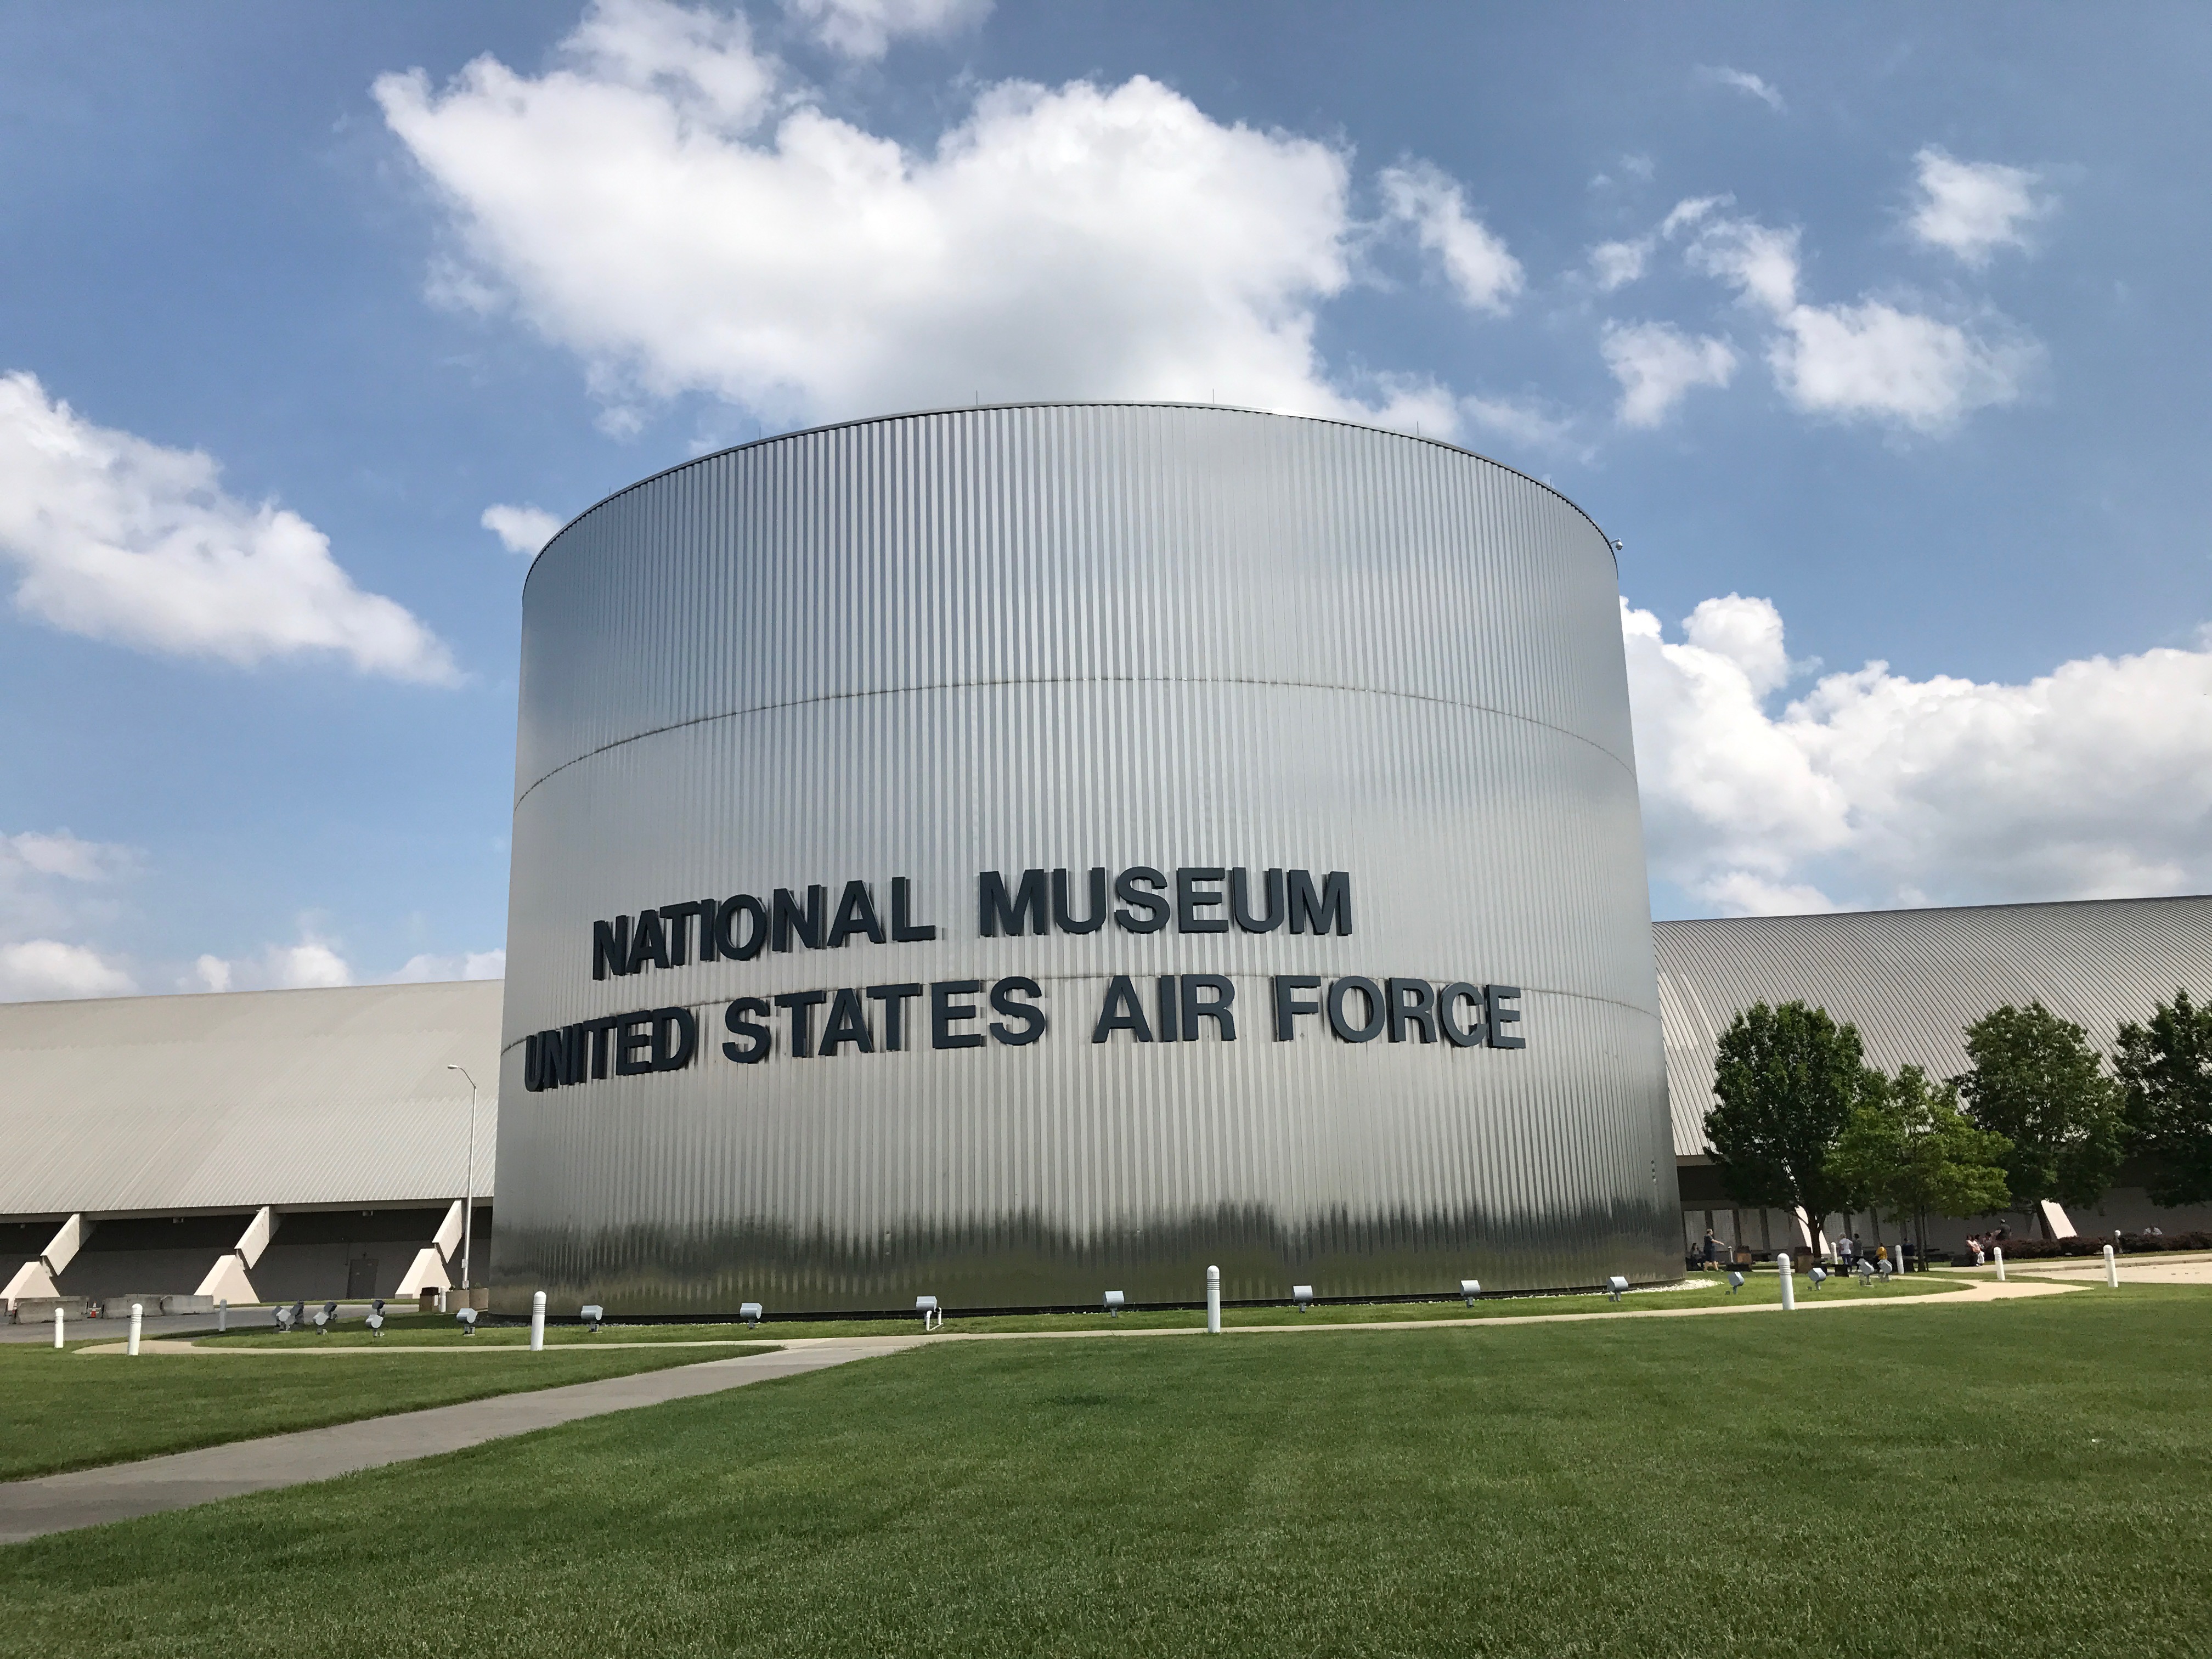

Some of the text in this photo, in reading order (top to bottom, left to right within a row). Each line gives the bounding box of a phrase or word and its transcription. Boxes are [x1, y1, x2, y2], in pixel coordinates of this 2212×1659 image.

[592, 866, 1352, 980] NATIONAL MUSEUM
[524, 974, 1526, 1092] UNITED STATES AIR FORCE
